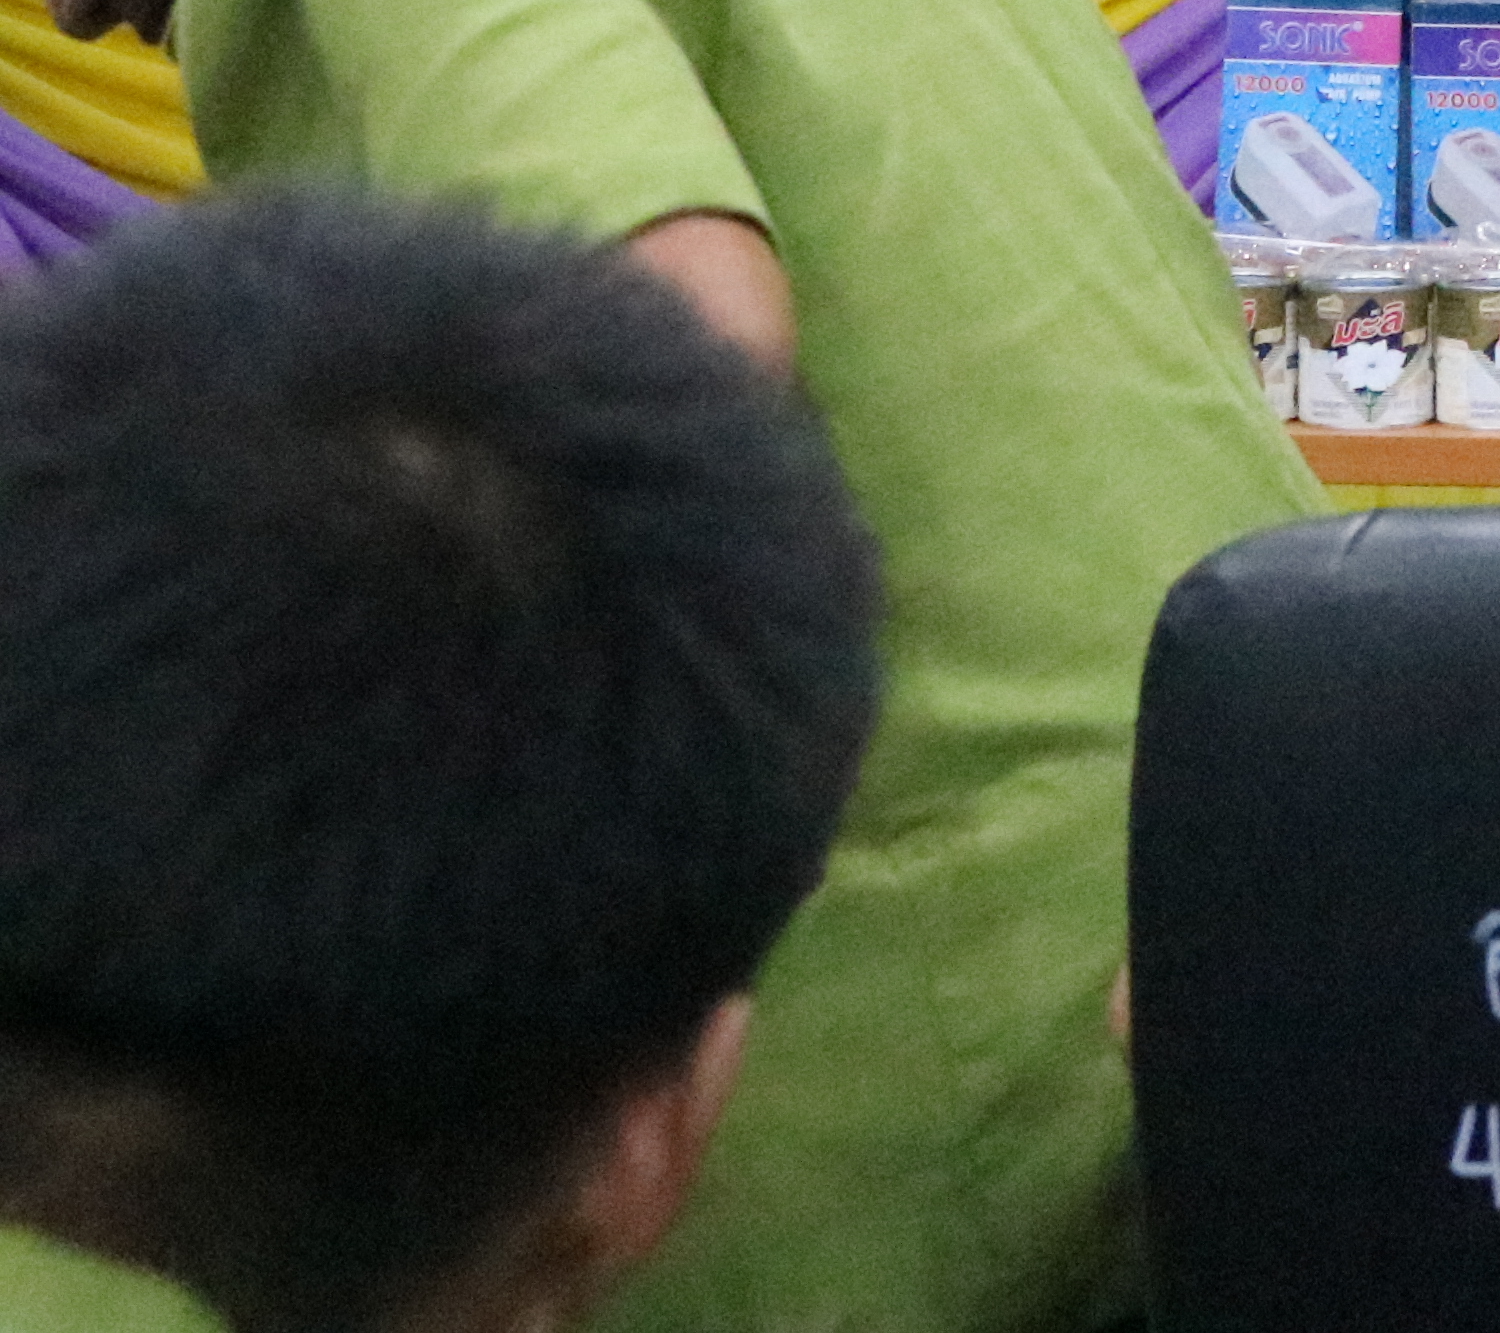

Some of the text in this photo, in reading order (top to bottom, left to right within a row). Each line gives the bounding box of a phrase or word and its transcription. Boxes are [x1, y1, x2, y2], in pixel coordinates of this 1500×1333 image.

[1259, 20, 1352, 55] SONIC
[1234, 74, 1305, 93] 12000
[1425, 90, 1499, 111] 12000
